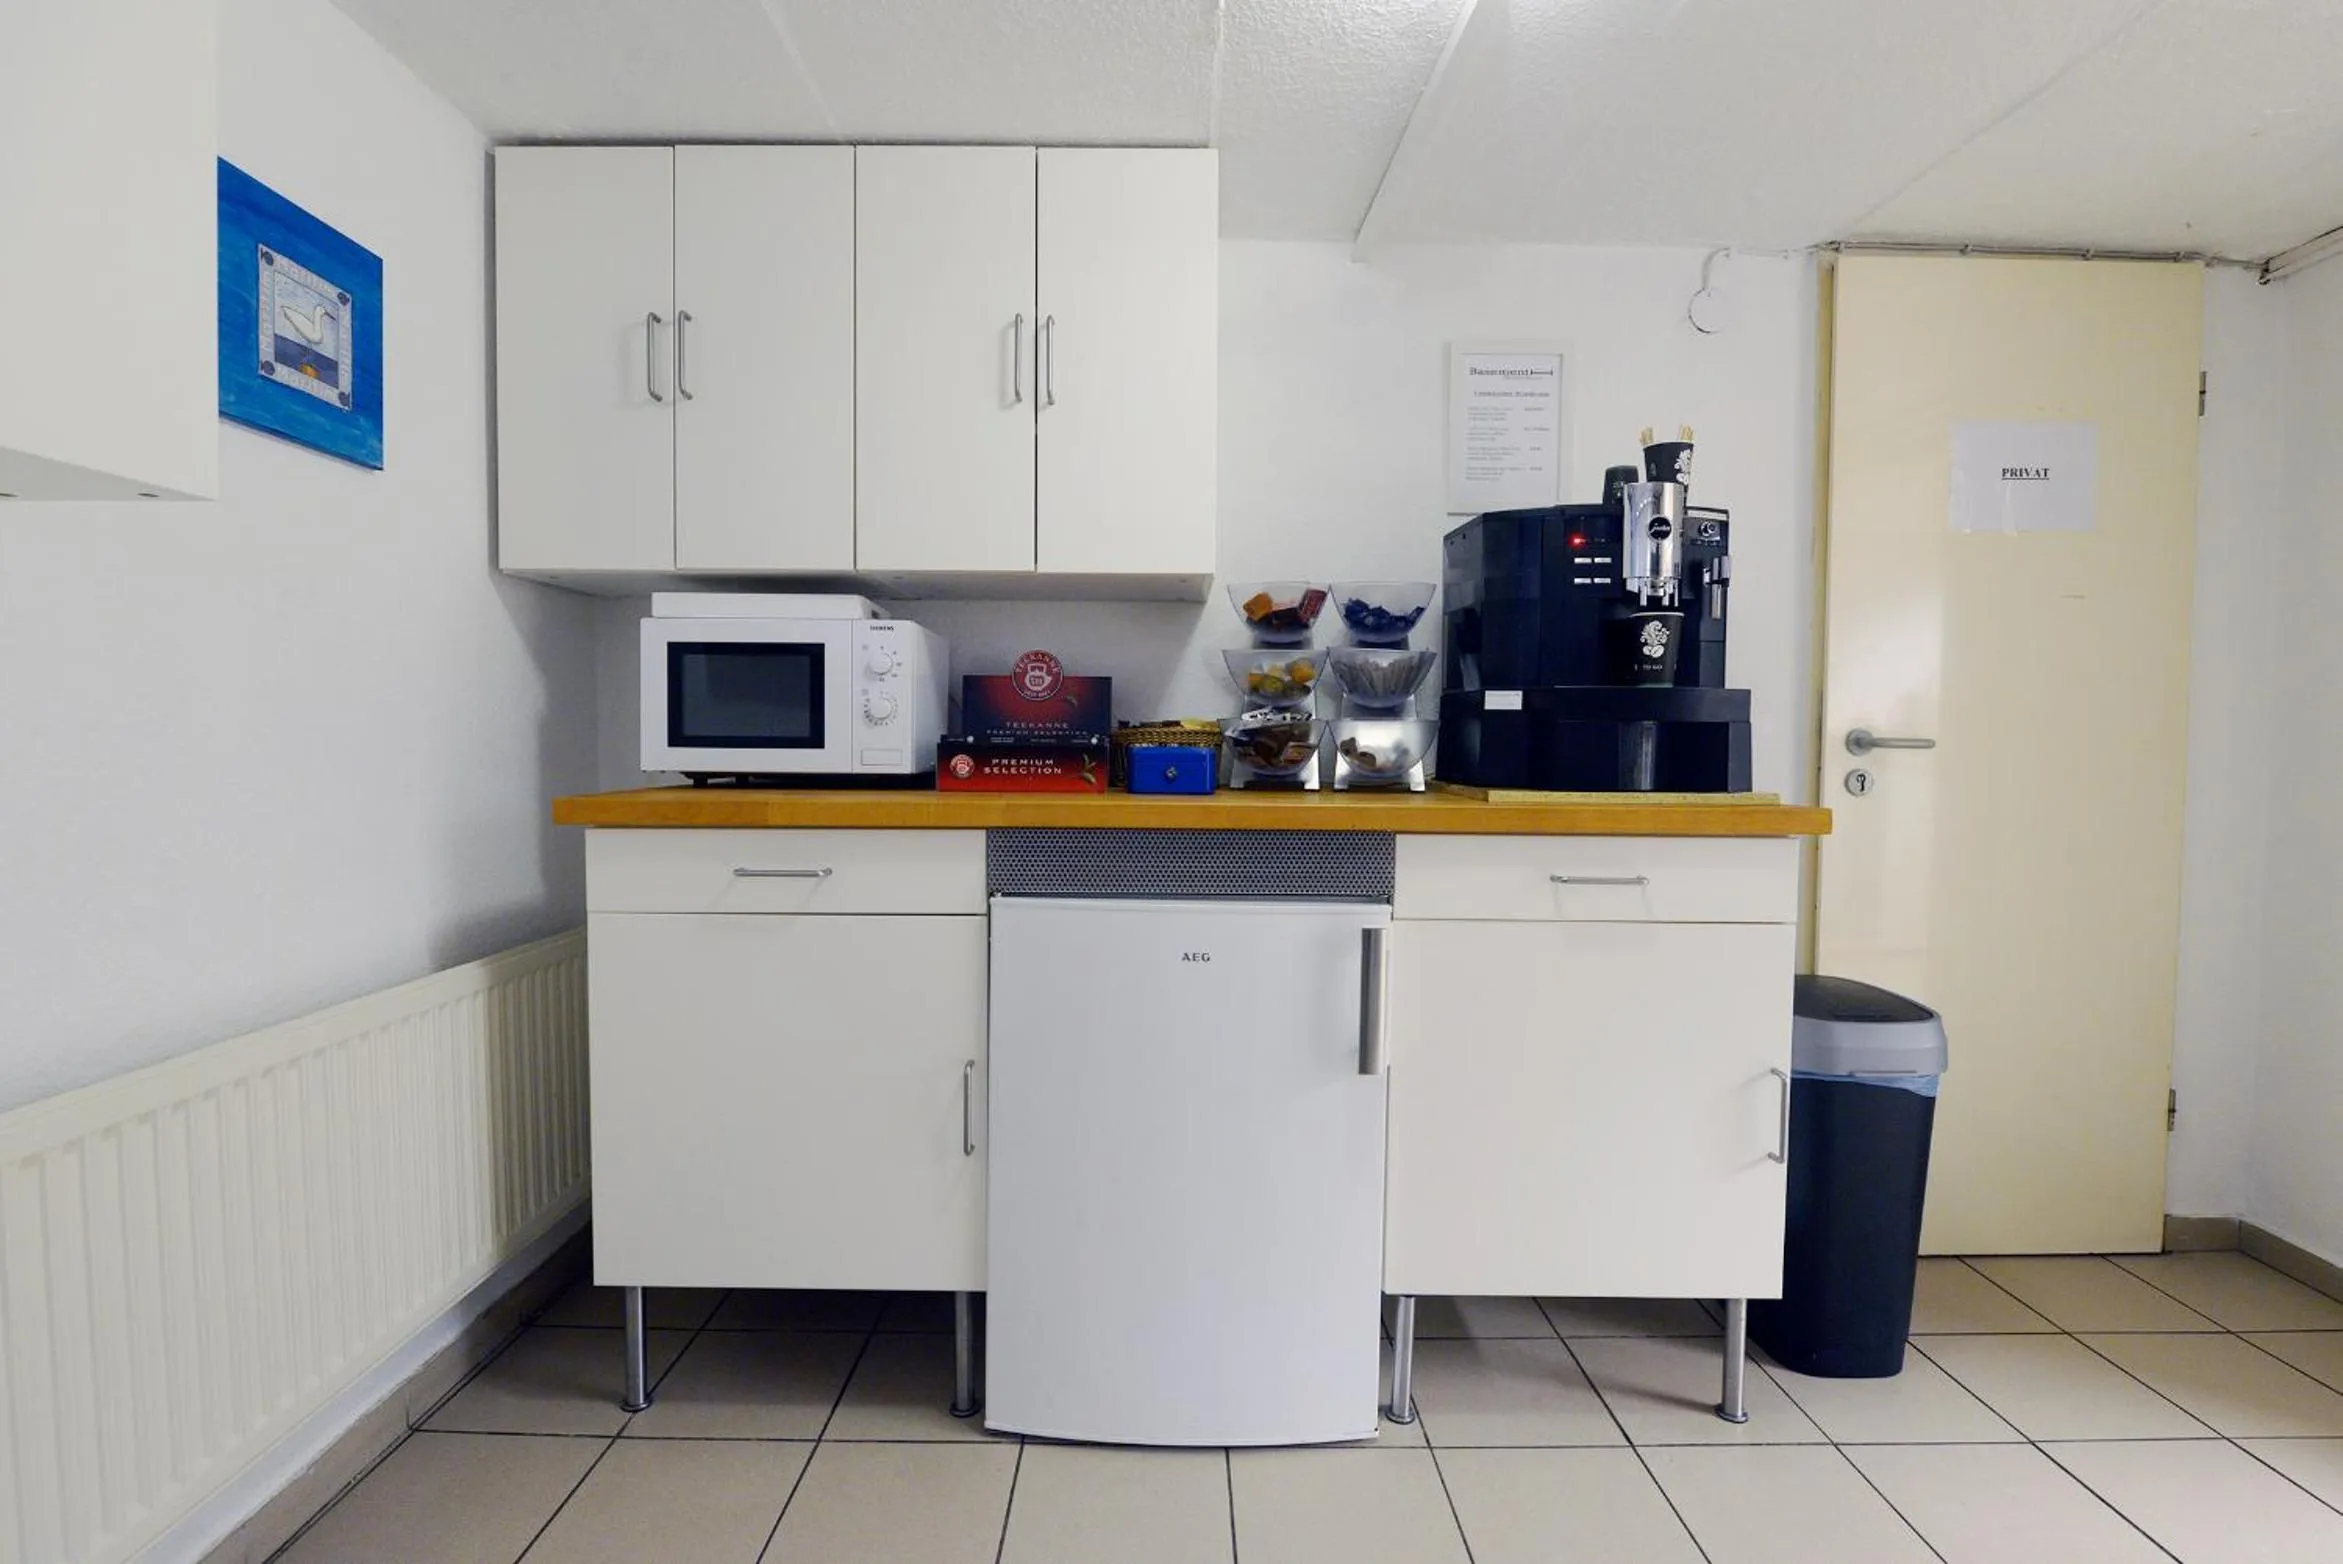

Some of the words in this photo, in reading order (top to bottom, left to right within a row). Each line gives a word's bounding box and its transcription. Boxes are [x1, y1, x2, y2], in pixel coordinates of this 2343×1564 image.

[2001, 467, 2050, 478] PRIVAT
[983, 767, 1063, 775] SELECTION
[1181, 952, 1211, 962] AEG
